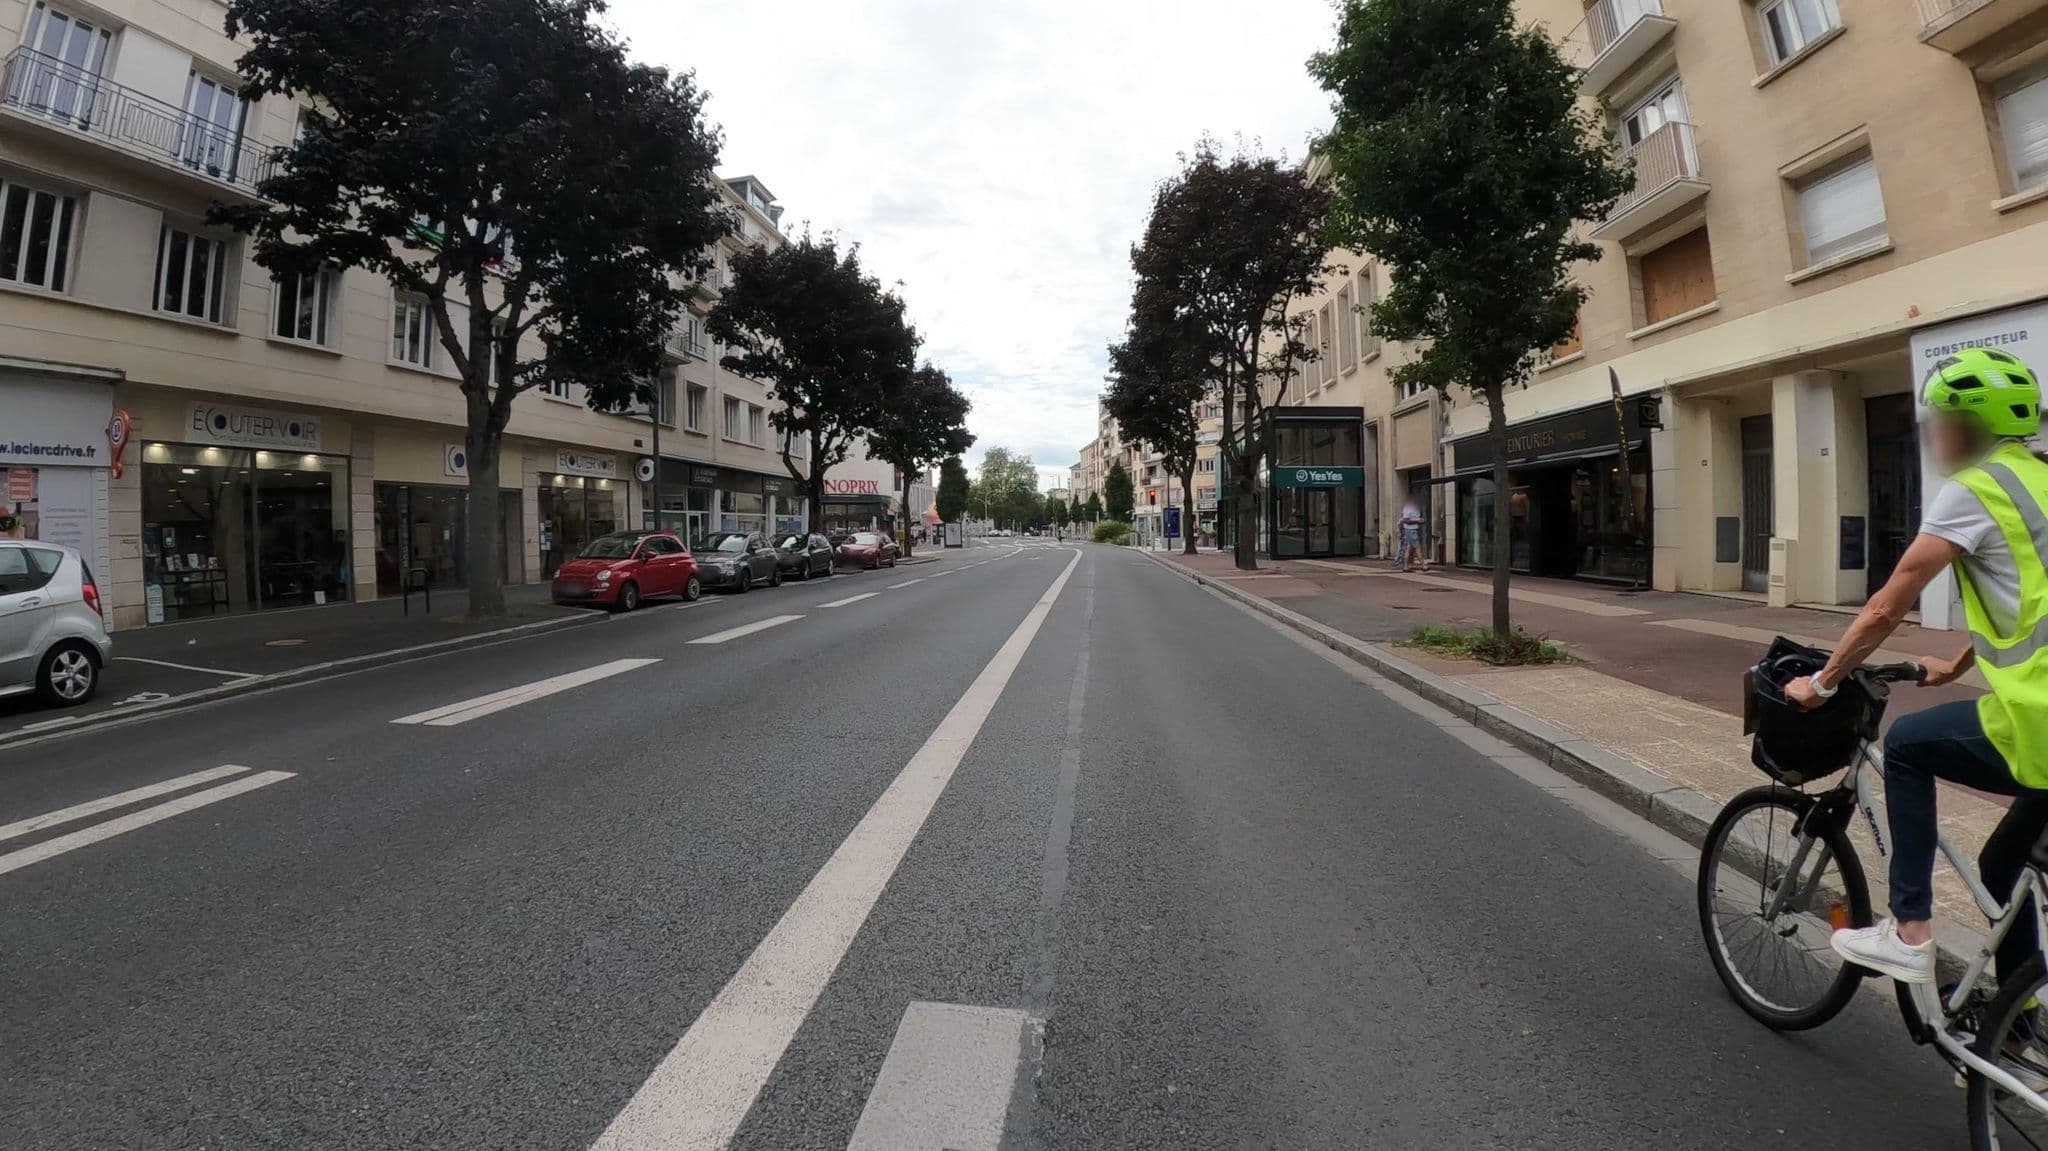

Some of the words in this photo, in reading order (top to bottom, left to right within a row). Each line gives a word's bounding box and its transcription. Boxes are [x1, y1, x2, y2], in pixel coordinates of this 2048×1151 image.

[1925, 330, 2029, 358] CONSTRUCTEUR
[278, 417, 317, 440] VOIR
[1309, 470, 1343, 481] YesYes
